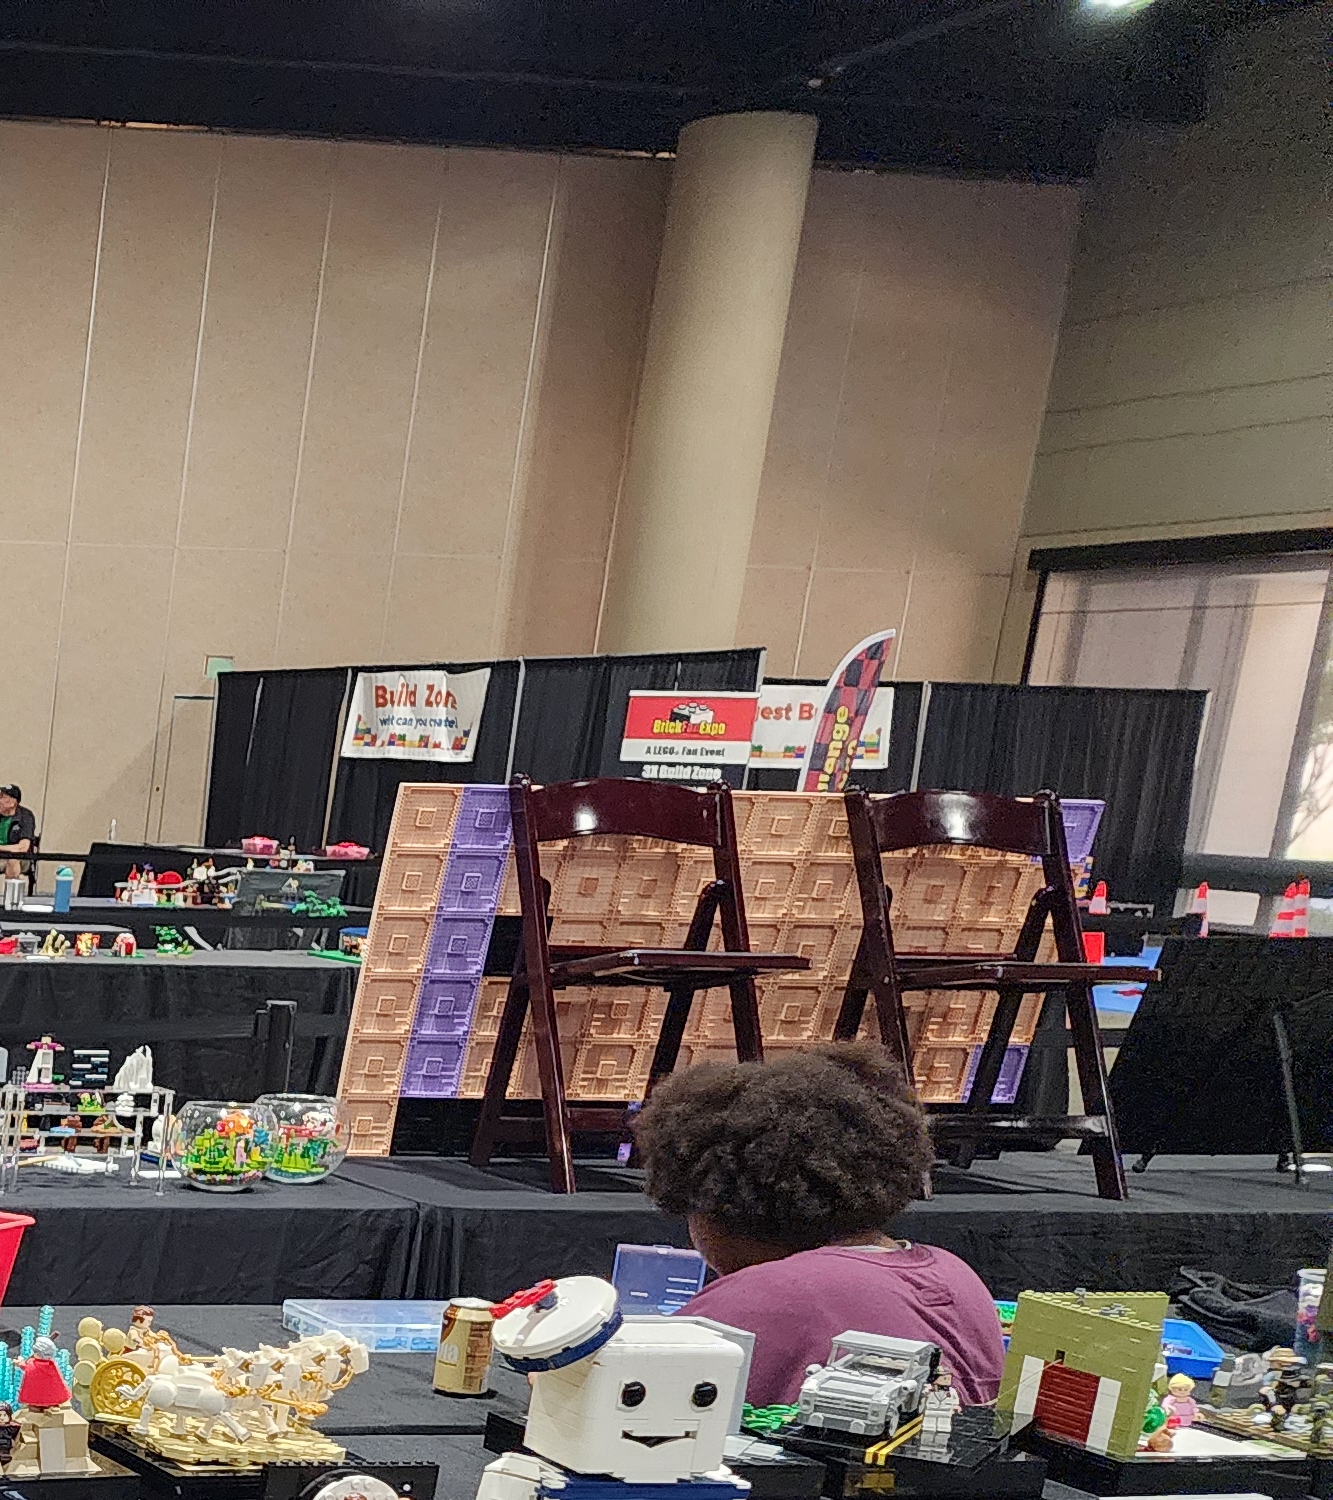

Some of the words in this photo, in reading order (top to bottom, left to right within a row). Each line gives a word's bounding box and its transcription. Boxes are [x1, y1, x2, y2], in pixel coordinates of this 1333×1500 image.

[375, 682, 417, 708] Build
[396, 716, 413, 727] can
[413, 717, 428, 730] you
[681, 746, 698, 756] Fan
[700, 746, 725, 757] Event
[659, 764, 692, 780] Build
[691, 765, 722, 780] Zone
